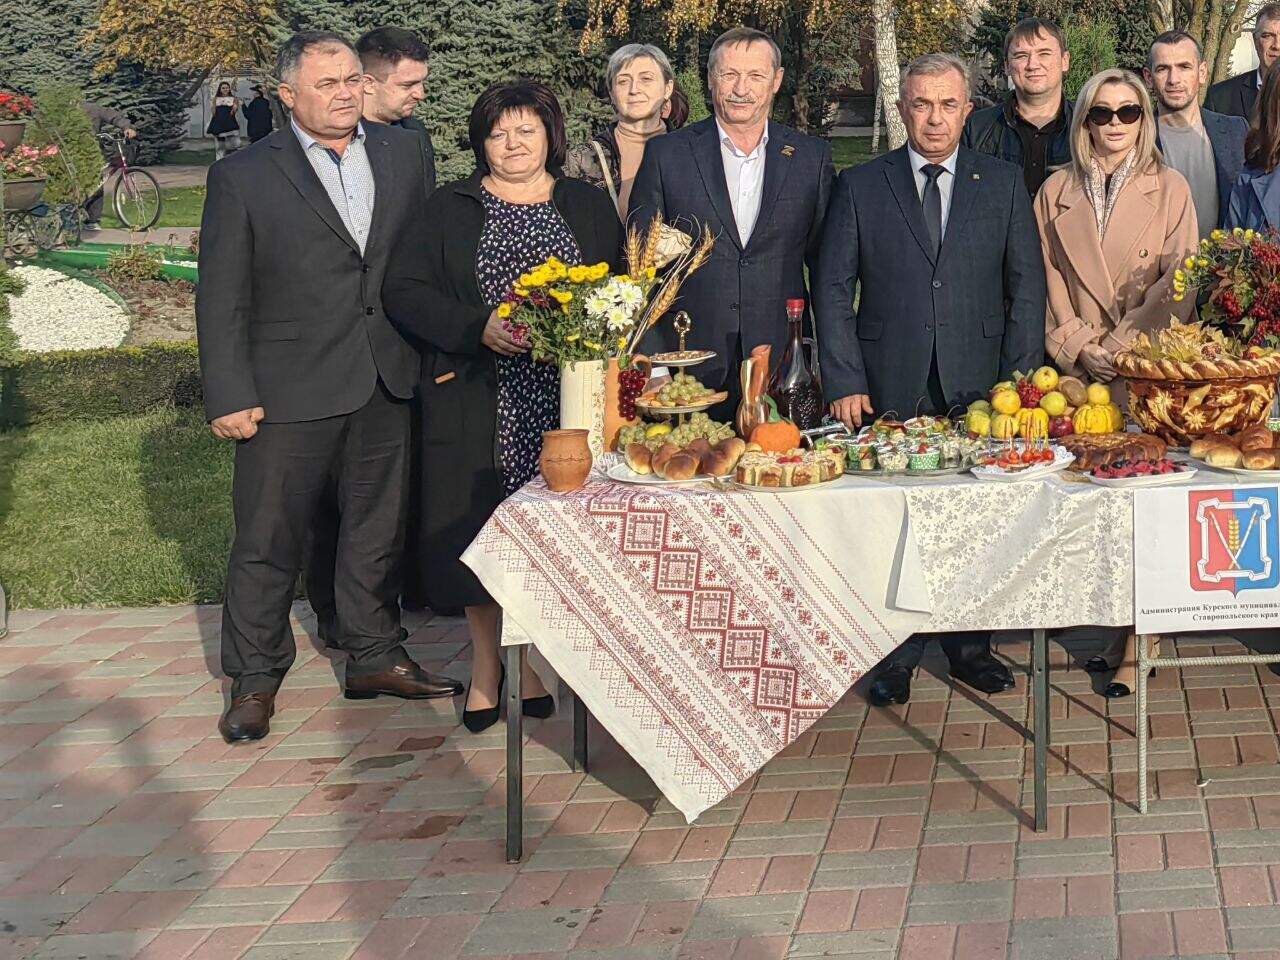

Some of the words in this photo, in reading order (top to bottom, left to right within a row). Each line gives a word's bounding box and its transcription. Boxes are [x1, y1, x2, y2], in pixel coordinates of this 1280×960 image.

[1140, 605, 1201, 615] Администрация
[1202, 603, 1238, 612] Курского
[1192, 613, 1259, 622] Ставропольского
[1260, 611, 1279, 620] края
